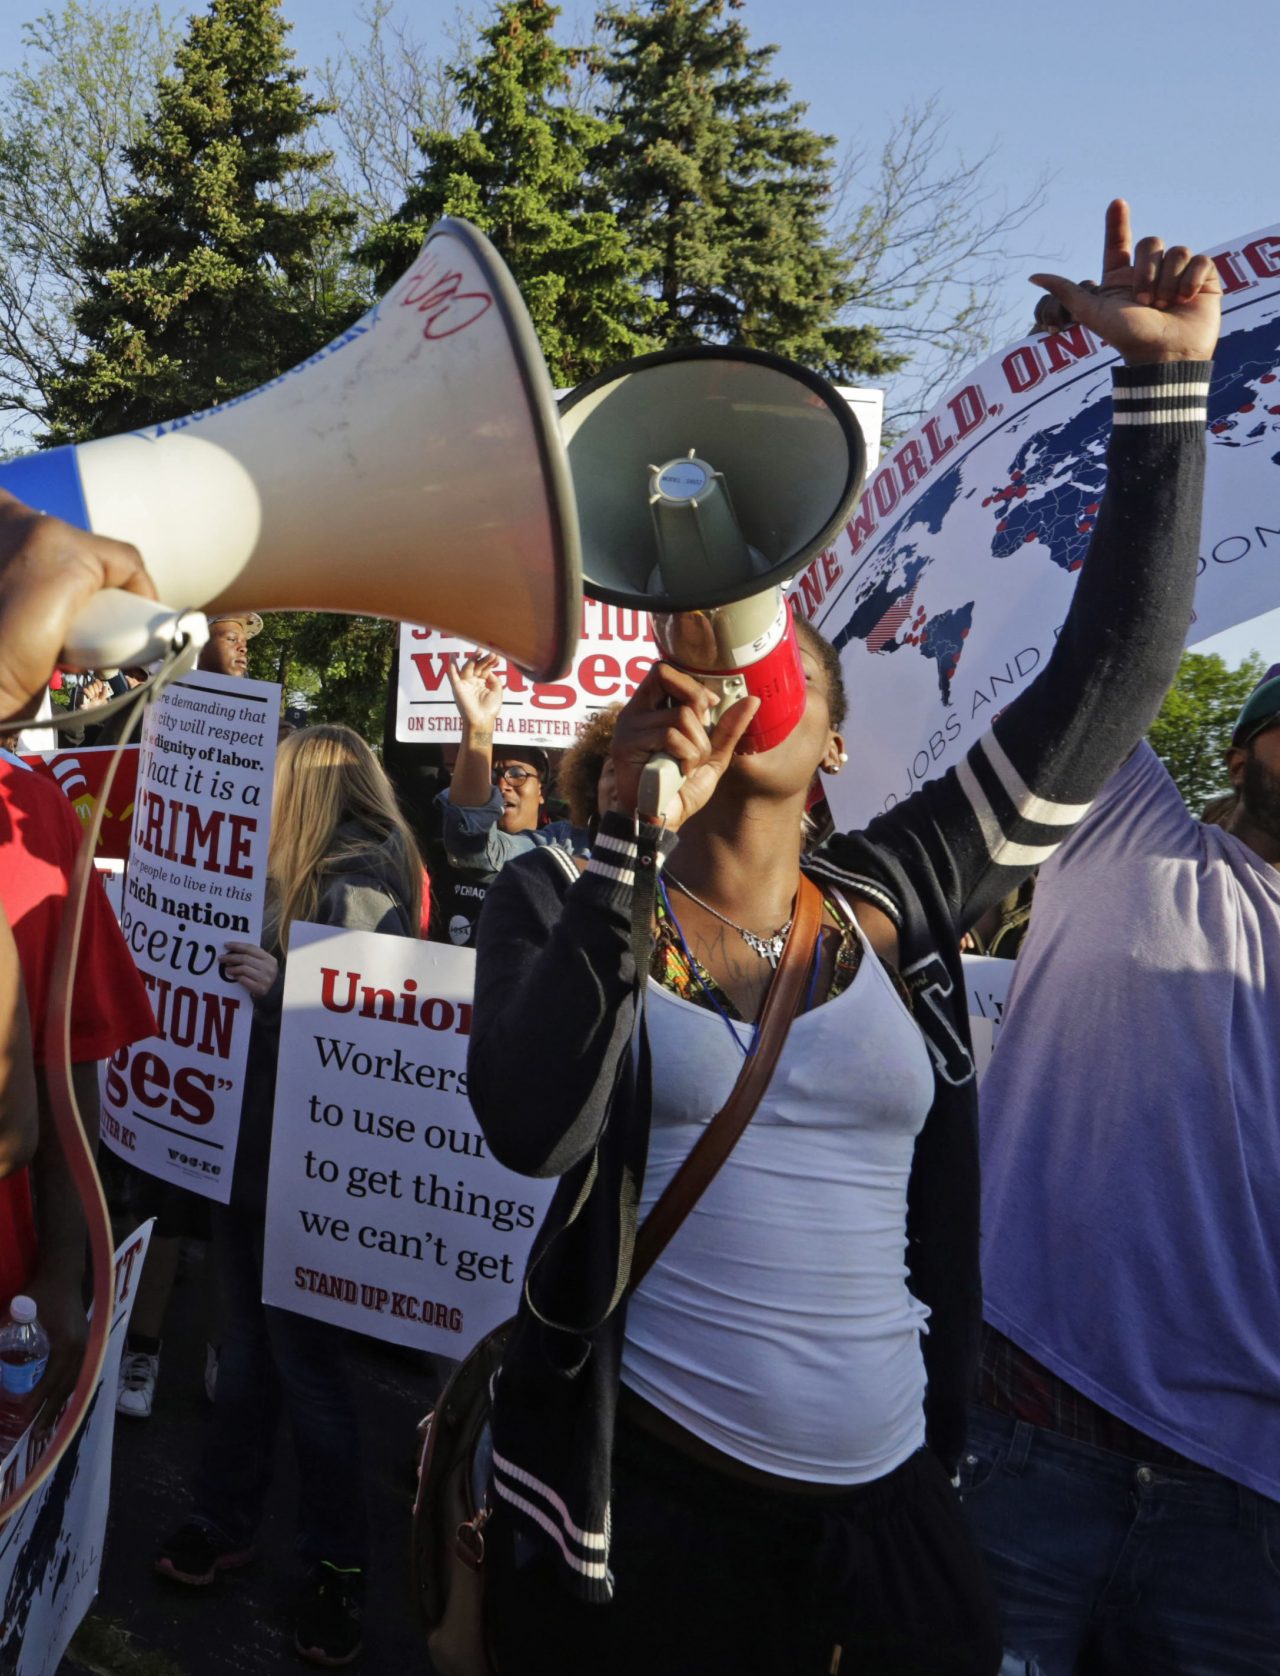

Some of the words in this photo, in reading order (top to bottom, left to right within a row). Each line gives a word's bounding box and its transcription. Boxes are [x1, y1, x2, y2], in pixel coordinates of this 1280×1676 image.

[1001, 322, 1111, 394] ON
[159, 712, 177, 731] city
[180, 717, 206, 736] will
[208, 726, 264, 747] respect
[171, 694, 236, 722] demanding
[239, 707, 266, 724] that
[408, 717, 424, 731] ON
[506, 718, 516, 732] A
[518, 718, 571, 736] BETTER
[905, 713, 962, 797] JOBS
[971, 647, 1041, 720] AND
[155, 734, 196, 760] dignity
[198, 746, 216, 762] of
[216, 748, 264, 771] labor.
[183, 765, 204, 795] it
[210, 771, 234, 801] is
[242, 785, 261, 807] a
[128, 876, 158, 910] rich
[160, 896, 250, 934] nation
[139, 861, 168, 880] people
[169, 872, 181, 886] to
[183, 875, 207, 892] live
[209, 882, 223, 897] in
[225, 886, 252, 902] this
[122, 910, 239, 984] eceiv
[314, 1035, 468, 1096] Workers
[308, 1094, 344, 1127] to
[353, 1108, 415, 1144] use
[304, 1150, 339, 1184] to
[346, 1165, 402, 1198] get
[412, 1173, 536, 1233] things
[299, 1210, 350, 1243] we
[358, 1222, 448, 1266] can’t
[455, 1249, 515, 1284] get
[295, 1266, 359, 1305] STAND
[360, 1286, 390, 1315] UP
[391, 1290, 463, 1333] KC.ORG
